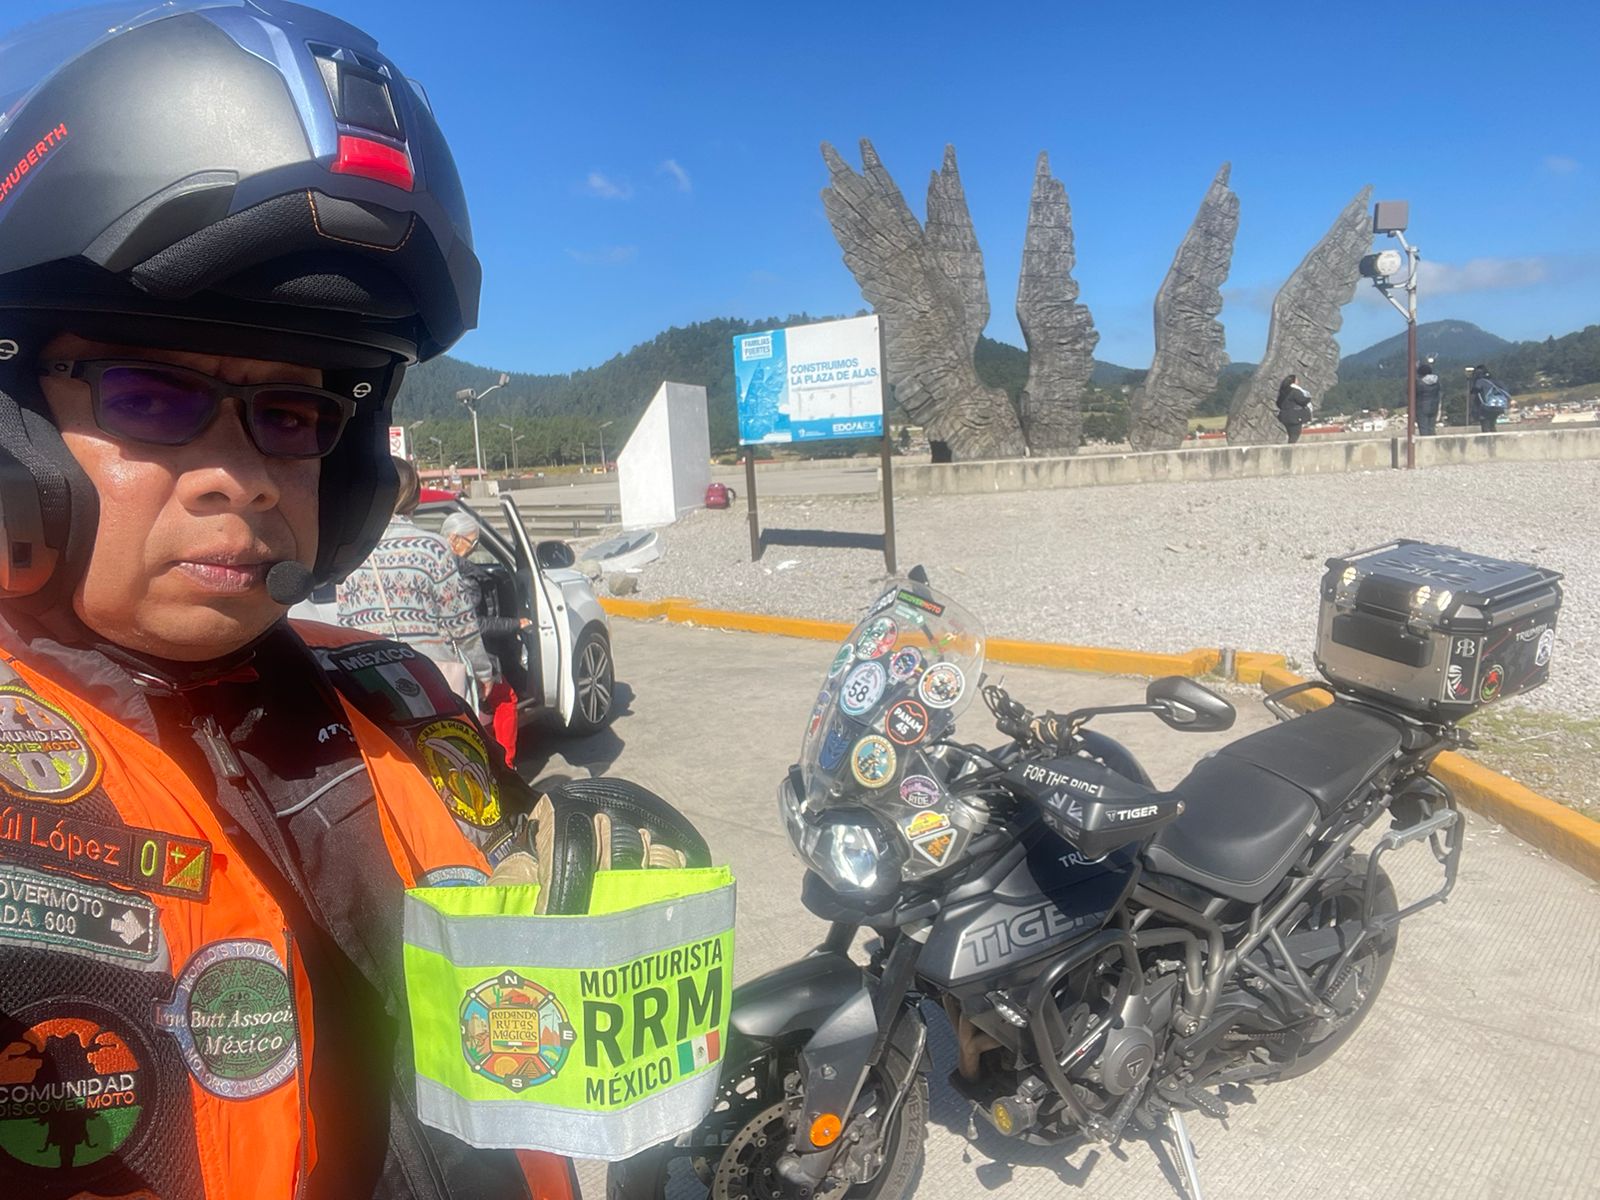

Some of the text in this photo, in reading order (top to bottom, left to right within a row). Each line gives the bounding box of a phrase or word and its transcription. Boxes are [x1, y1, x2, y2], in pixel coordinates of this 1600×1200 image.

[790, 358, 858, 374] CONSTRUIMOS
[791, 376, 802, 386] LA
[804, 373, 834, 384] PLAZA
[836, 370, 850, 381] DE
[848, 681, 869, 703] 58
[893, 706, 924, 733] PANAM
[895, 721, 910, 735] 45
[1022, 764, 1046, 783] FOR
[1117, 805, 1159, 821] TIGER
[30, 819, 121, 866] López
[43, 911, 77, 935] 600
[579, 937, 723, 999] MOTOTURISTA
[504, 975, 518, 985] N
[190, 1009, 226, 1029] Butt
[227, 1004, 294, 1029] Associ
[582, 966, 723, 1069] RRM
[202, 1033, 284, 1056] México
[562, 1030, 574, 1040] E
[511, 1078, 523, 1088] S
[586, 1056, 673, 1105] MÉXICO
